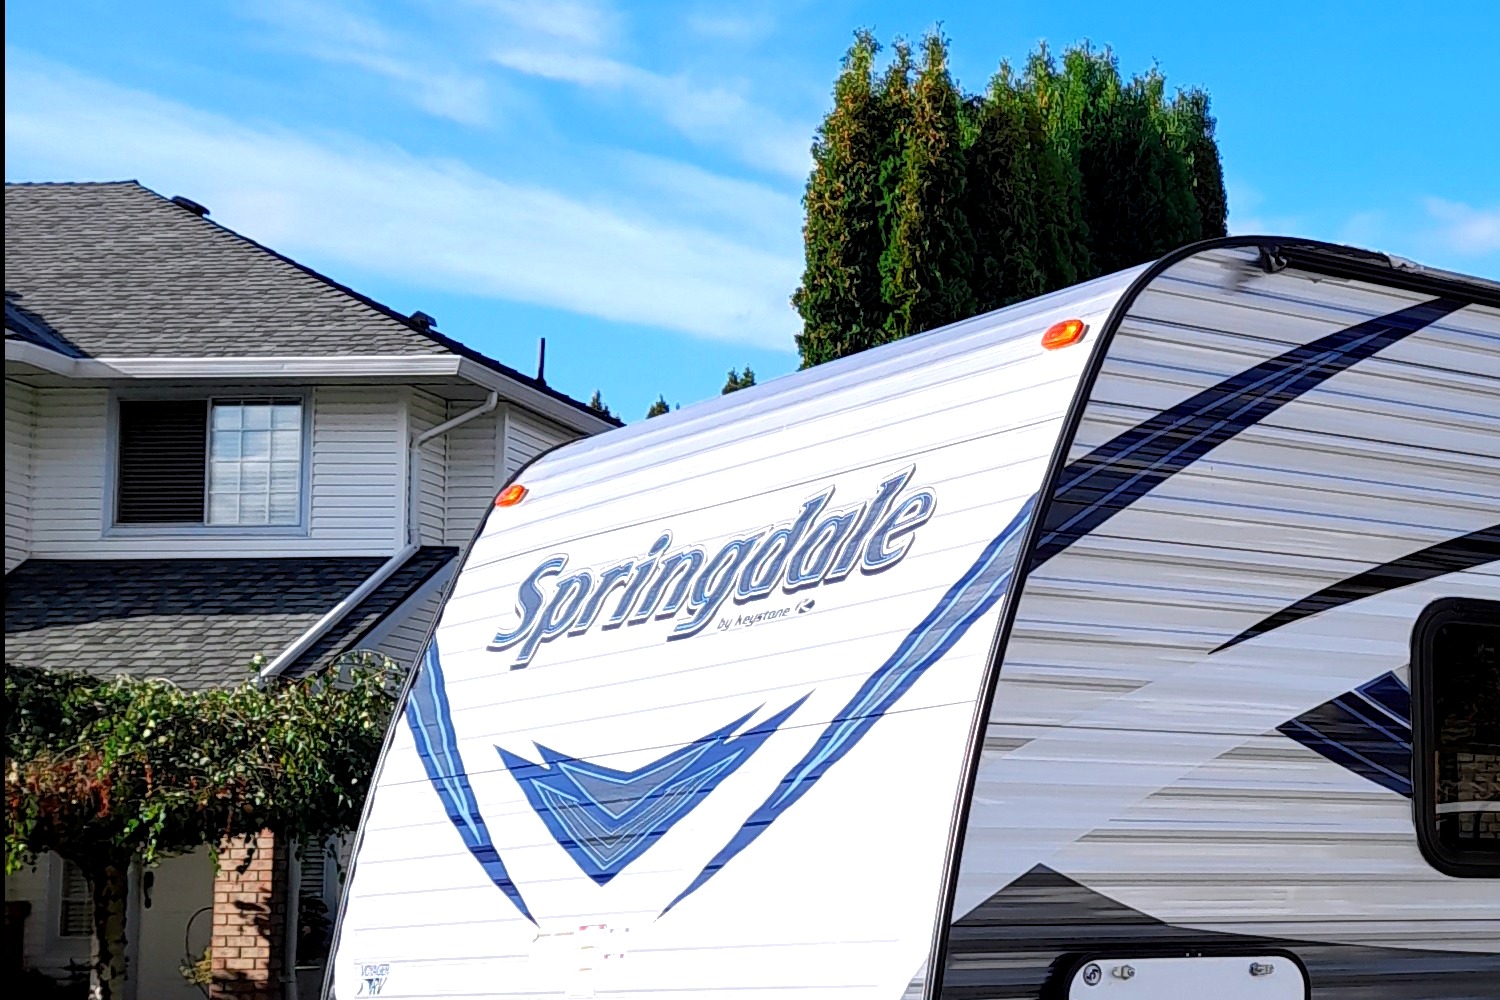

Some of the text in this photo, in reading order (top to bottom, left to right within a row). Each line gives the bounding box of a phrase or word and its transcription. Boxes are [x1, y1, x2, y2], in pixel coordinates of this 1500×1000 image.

[486, 464, 937, 670] Springdale
[717, 607, 790, 632] by keystone
